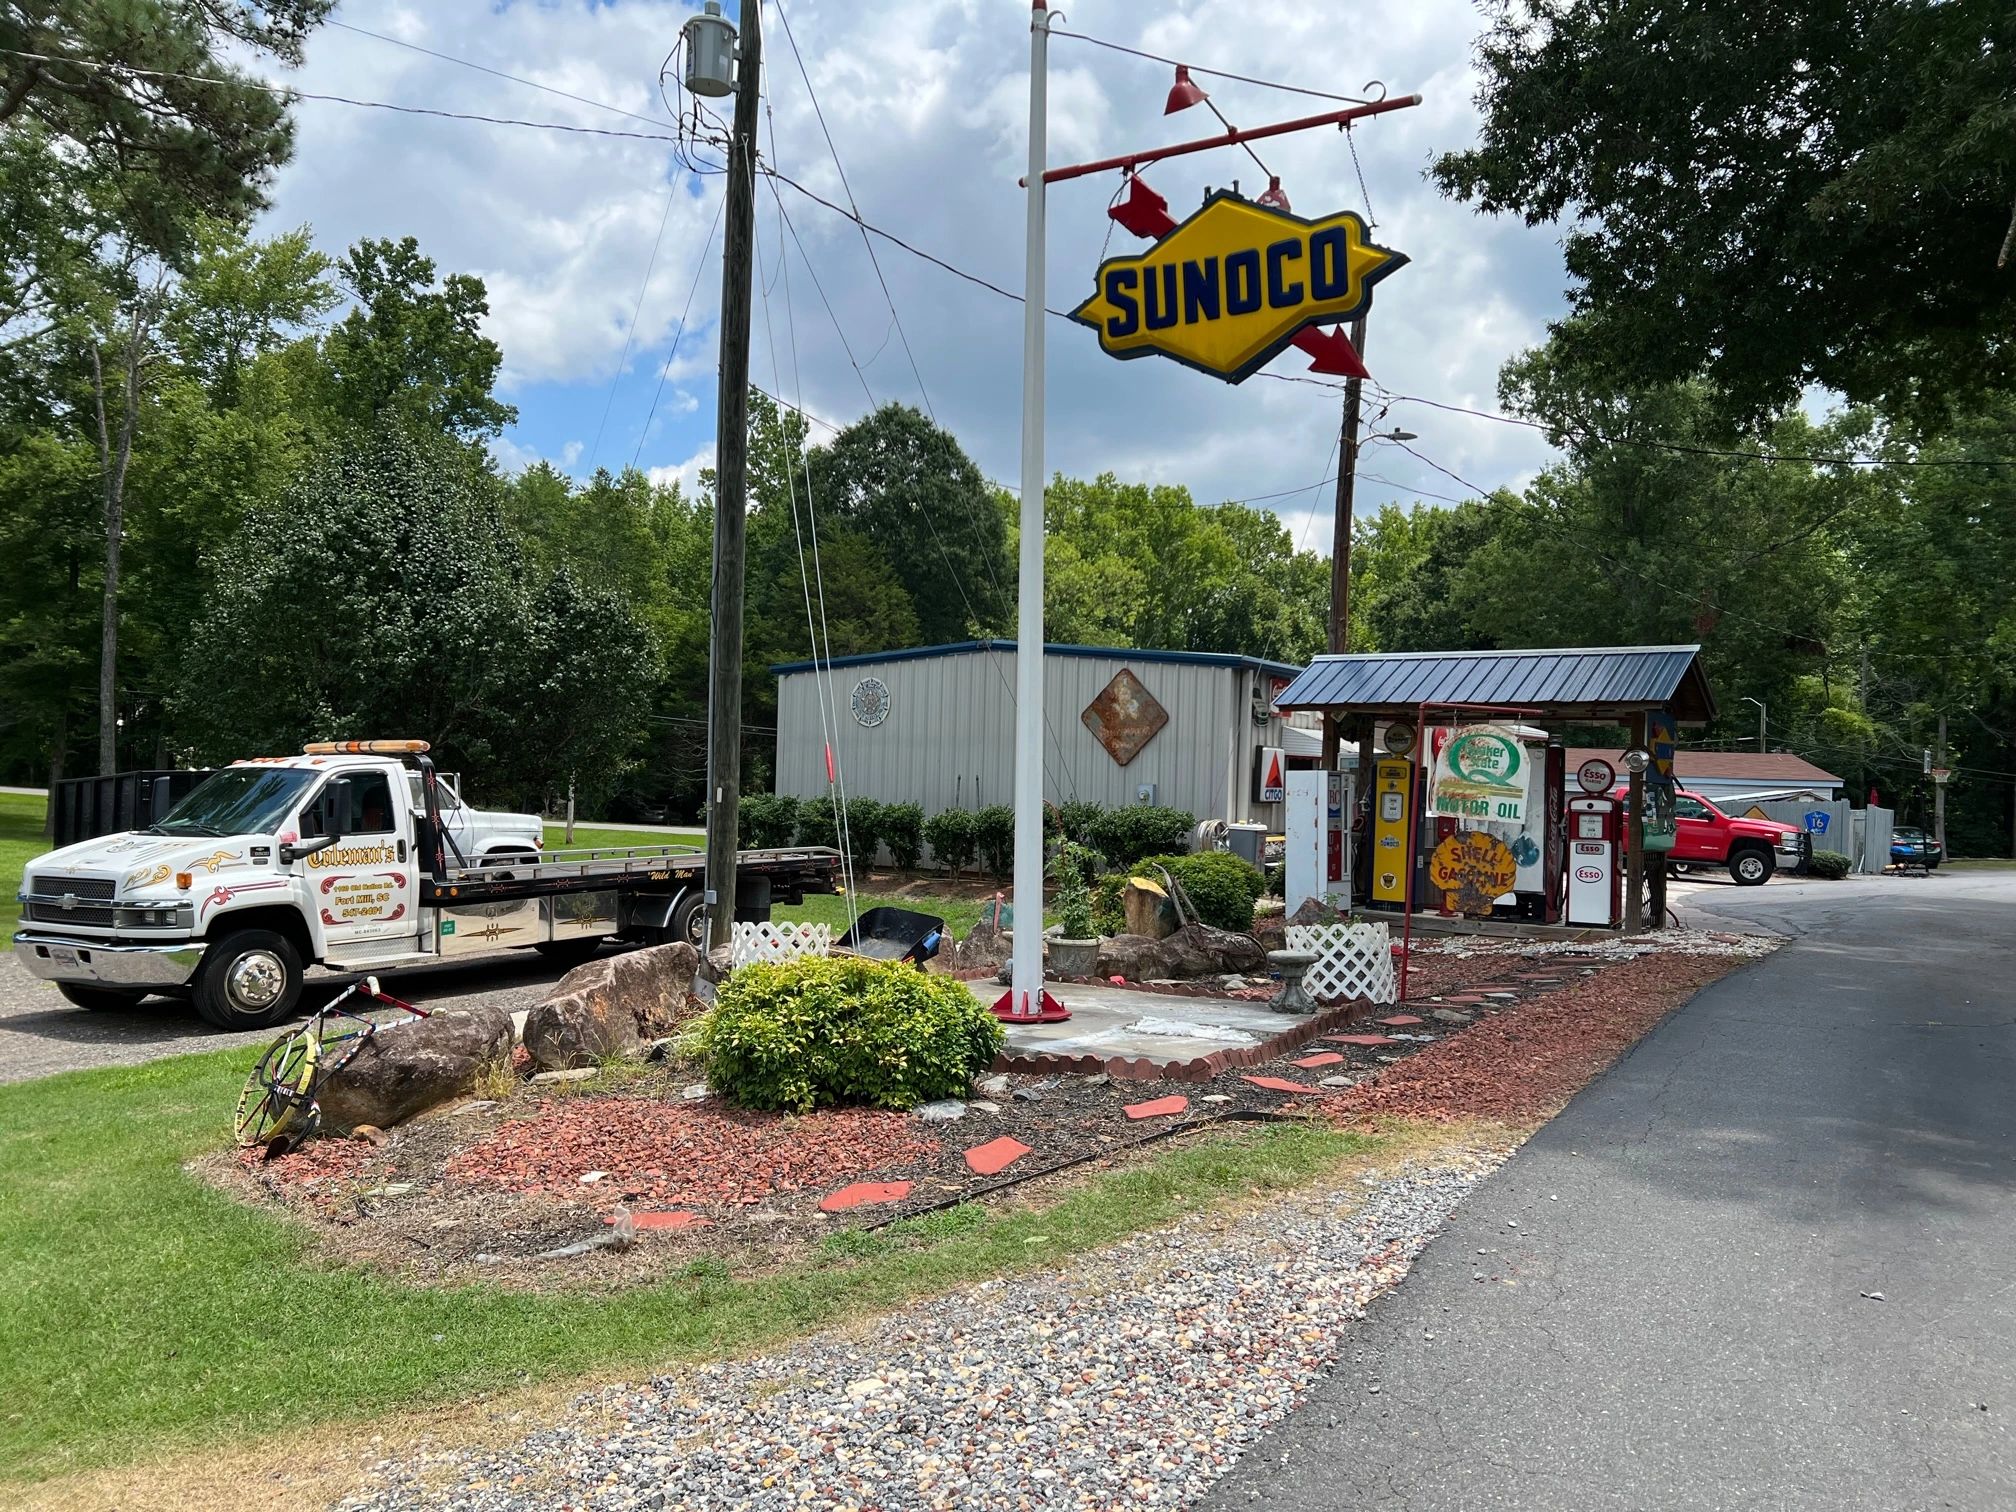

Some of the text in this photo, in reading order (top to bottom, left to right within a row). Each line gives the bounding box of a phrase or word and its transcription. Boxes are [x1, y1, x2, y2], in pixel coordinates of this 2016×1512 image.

[1105, 226, 1348, 338] SUNOCO
[1583, 768, 1606, 781] Esso
[1264, 789, 1282, 800] CITGO
[1436, 796, 1521, 820] MOTOR OIL
[1812, 818, 1824, 828] 16
[307, 839, 396, 869] Coleman's
[1580, 843, 1600, 852] Esso
[1450, 847, 1503, 863] SHELL
[1579, 869, 1600, 879] Esso
[335, 892, 390, 906] Fort Mill, SC
